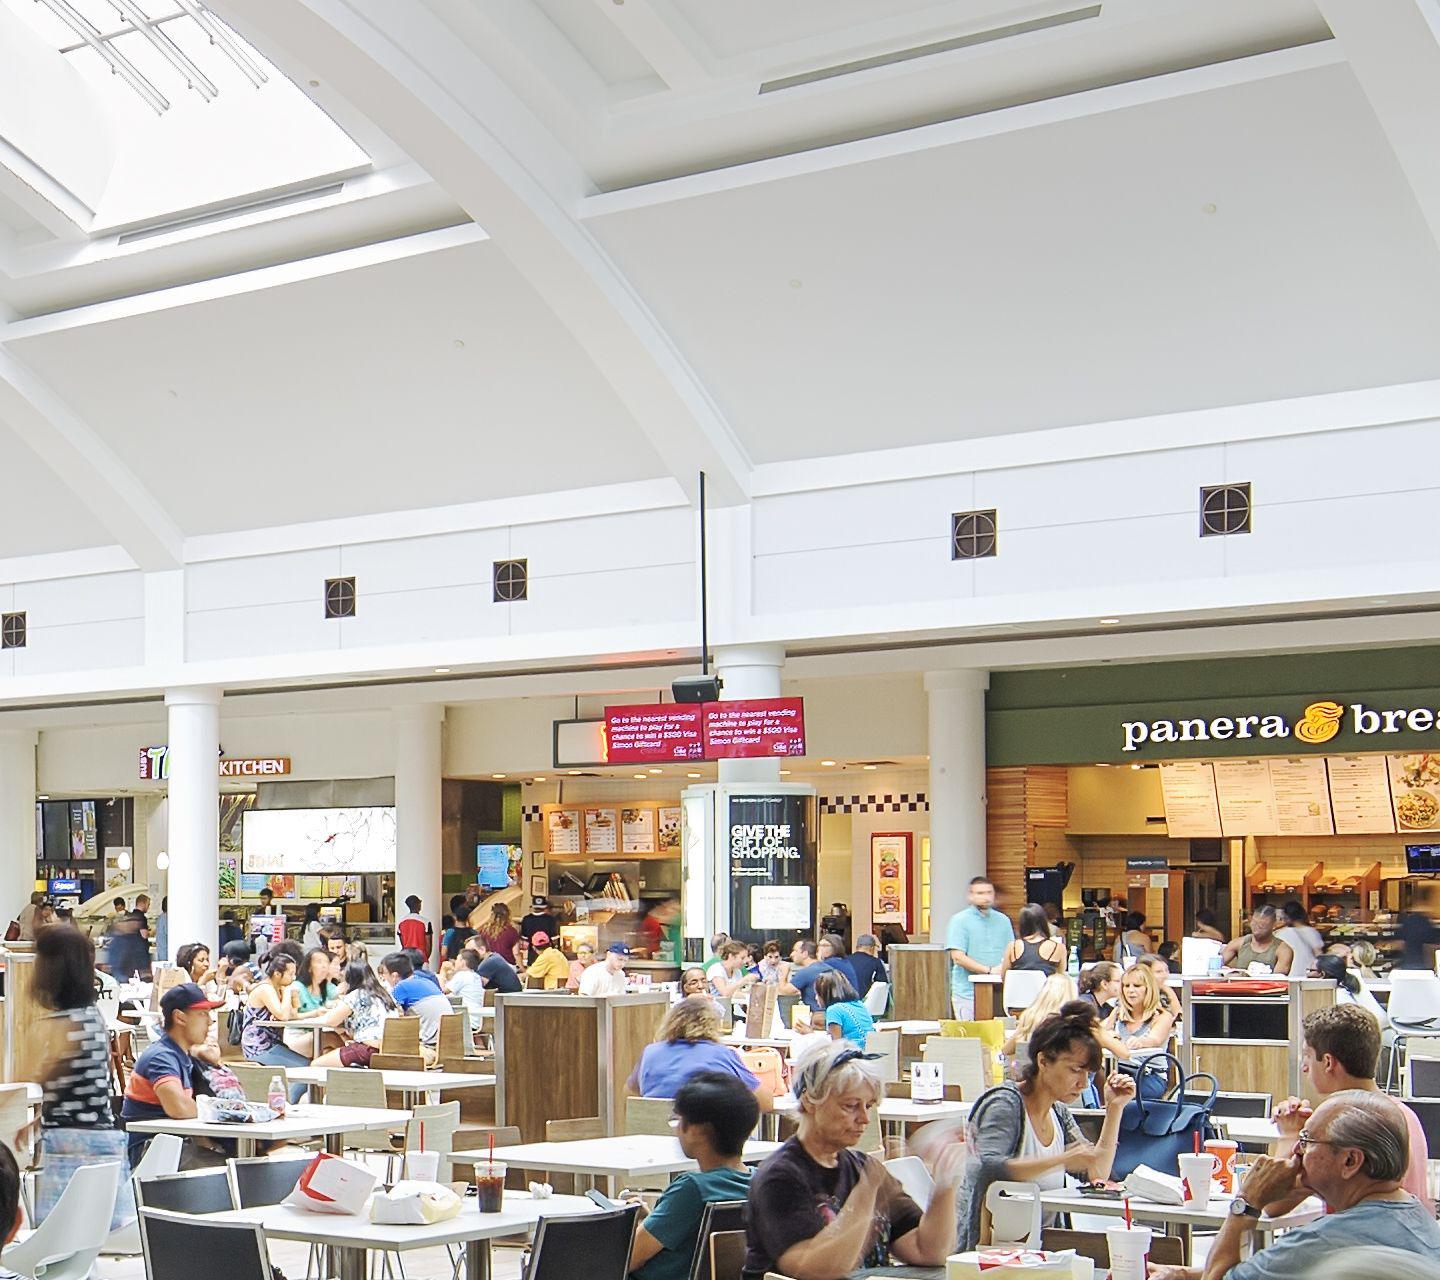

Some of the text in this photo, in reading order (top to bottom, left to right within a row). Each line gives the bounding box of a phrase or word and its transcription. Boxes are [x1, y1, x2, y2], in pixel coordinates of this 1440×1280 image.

[1121, 713, 1290, 751] panera
[140, 749, 148, 778] RUBY
[219, 759, 284, 776] KITCHEN
[731, 824, 791, 838] GIVE THE
[731, 836, 783, 848] GIFT OF
[731, 847, 801, 859] SHOPPING.
